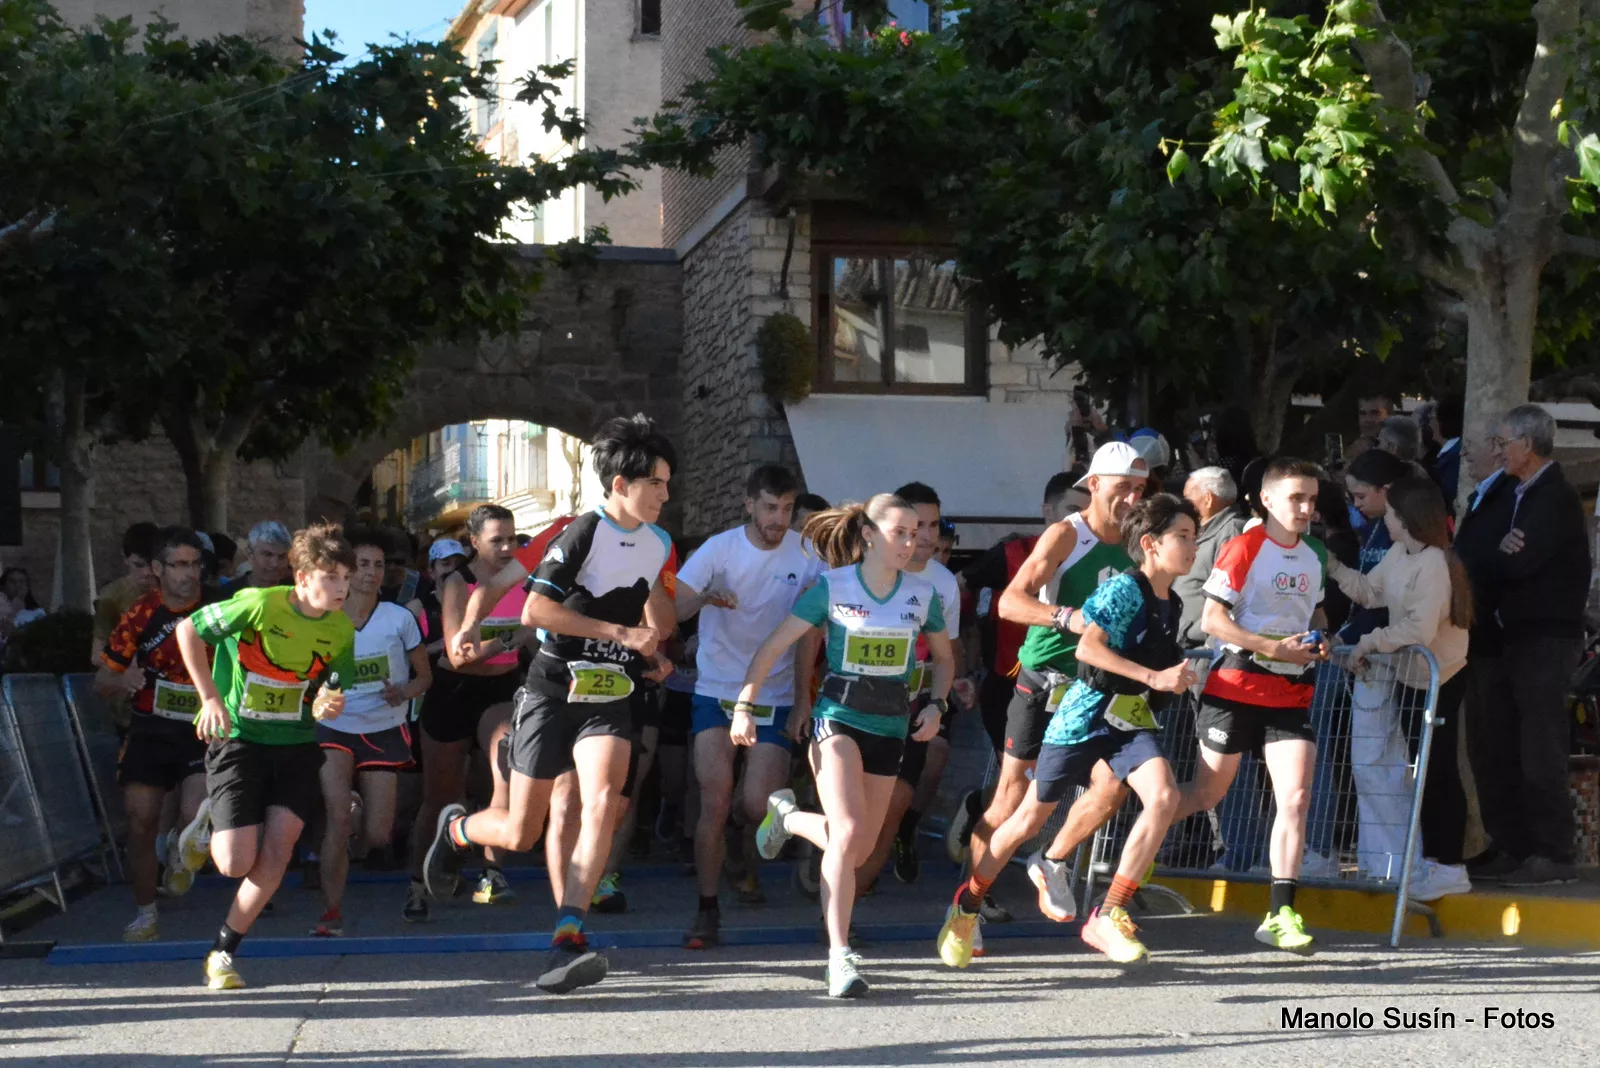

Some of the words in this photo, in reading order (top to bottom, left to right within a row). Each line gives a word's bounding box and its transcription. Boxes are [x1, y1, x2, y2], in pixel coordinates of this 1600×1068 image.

[860, 643, 896, 658] 118
[354, 662, 380, 677] 00
[858, 659, 894, 667] BEATRIZ
[592, 673, 615, 688] 25
[167, 692, 198, 708] 209
[264, 691, 286, 707] 31
[586, 689, 616, 697] DANIEL
